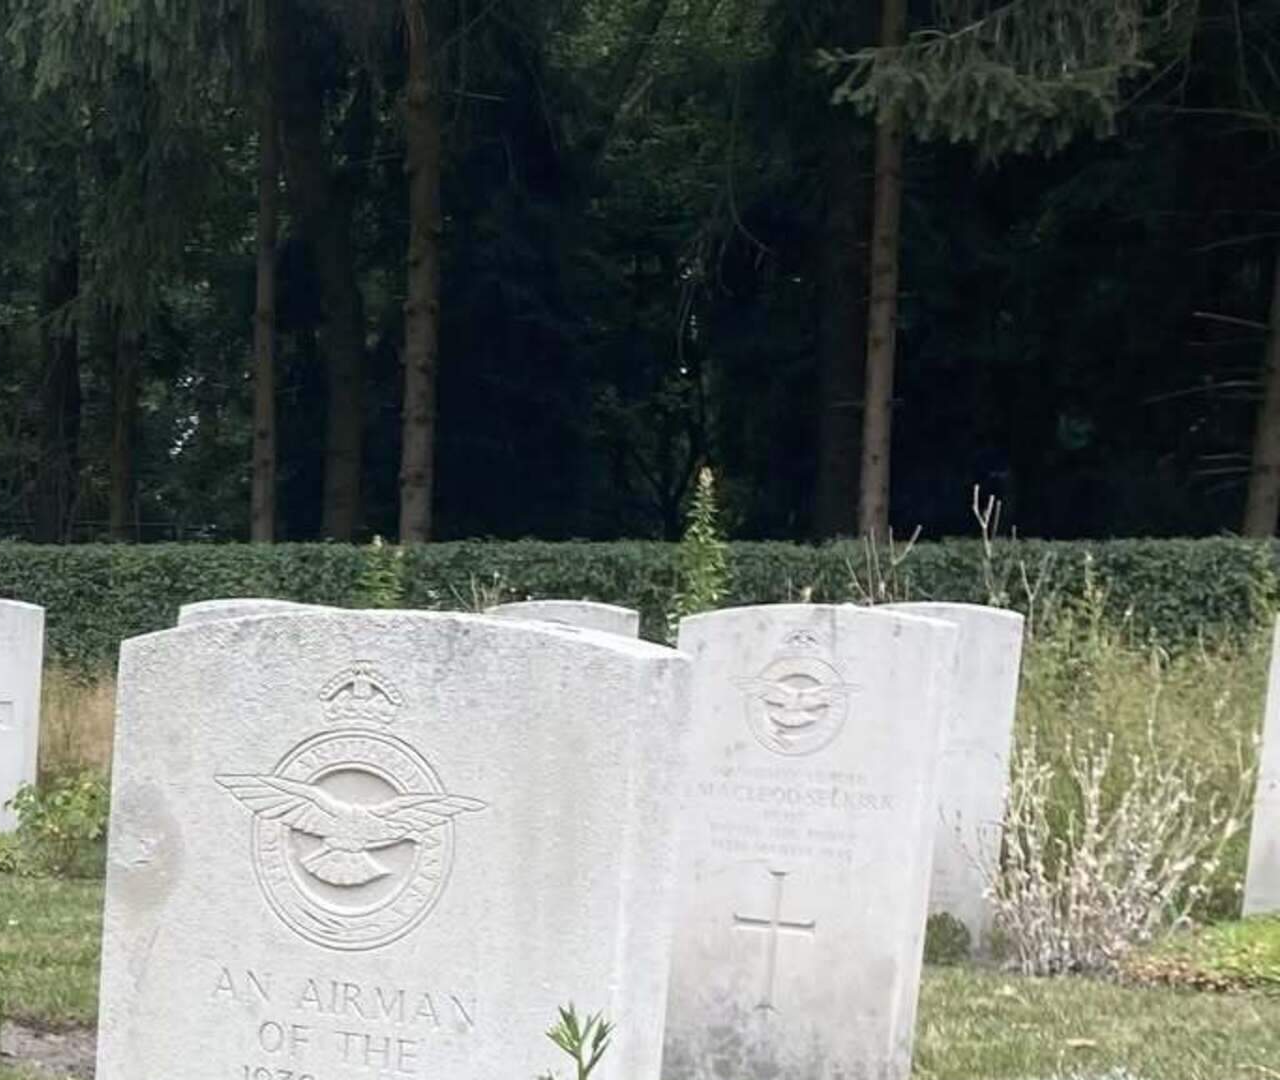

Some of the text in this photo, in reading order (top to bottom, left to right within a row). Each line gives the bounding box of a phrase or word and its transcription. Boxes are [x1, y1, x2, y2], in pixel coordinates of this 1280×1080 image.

[210, 966, 478, 1032] AN AIRMAN
[258, 1019, 423, 1075] OF THE
